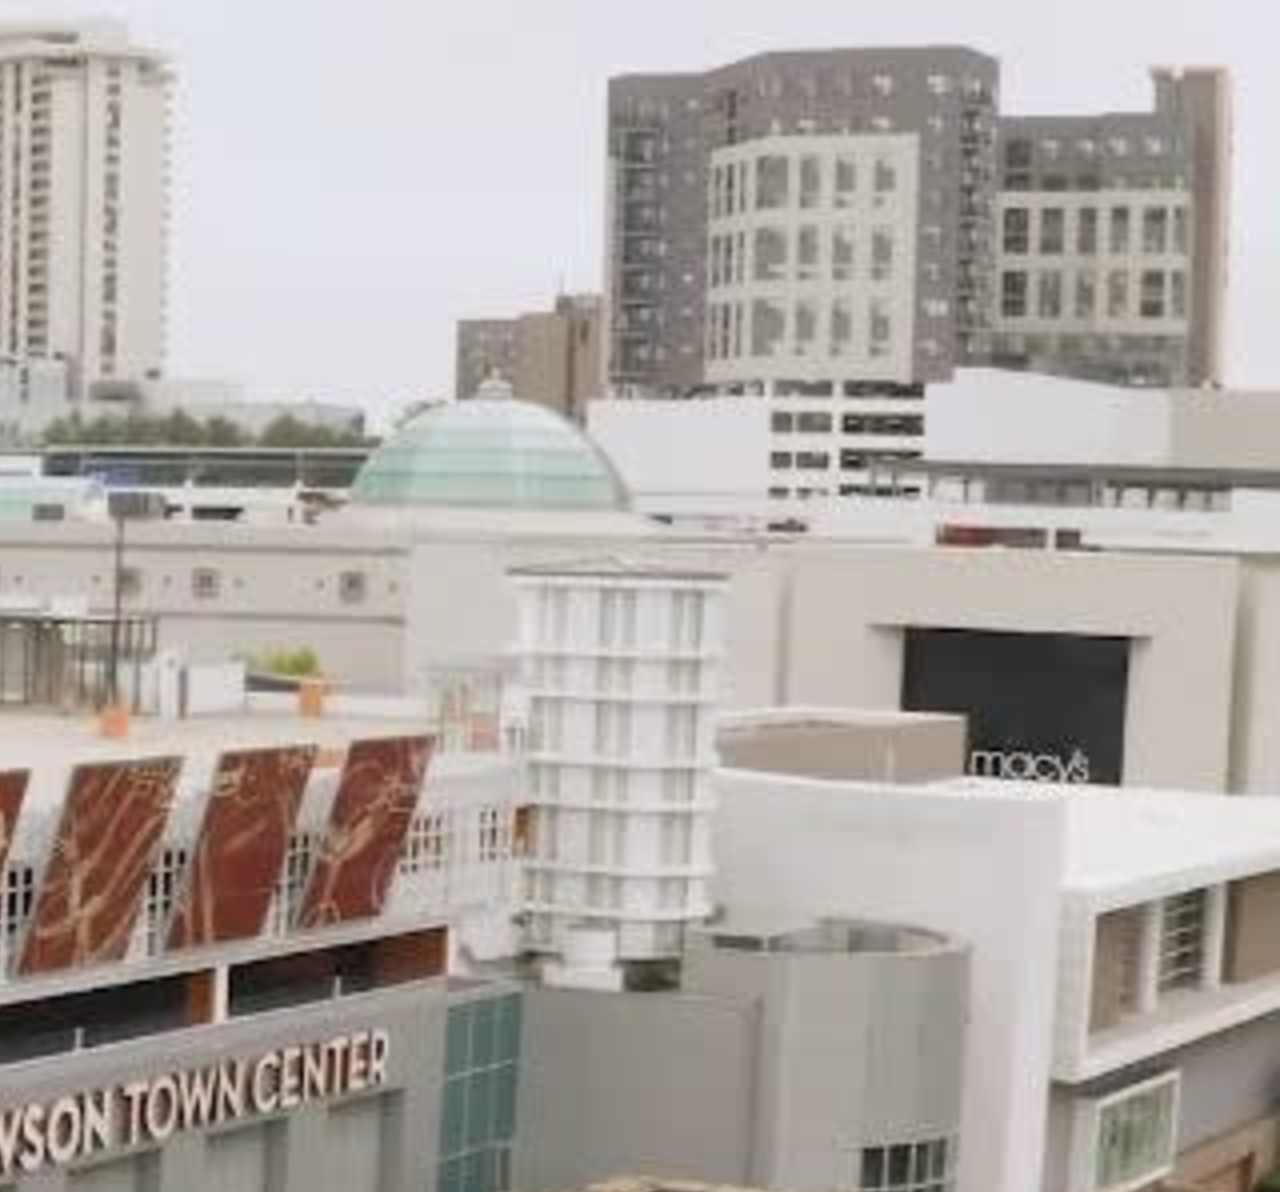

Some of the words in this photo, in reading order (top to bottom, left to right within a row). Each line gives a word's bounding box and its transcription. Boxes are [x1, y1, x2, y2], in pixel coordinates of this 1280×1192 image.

[972, 749, 1089, 784] macy's
[124, 1060, 246, 1139] TOWN
[253, 1028, 390, 1111] CENTER
